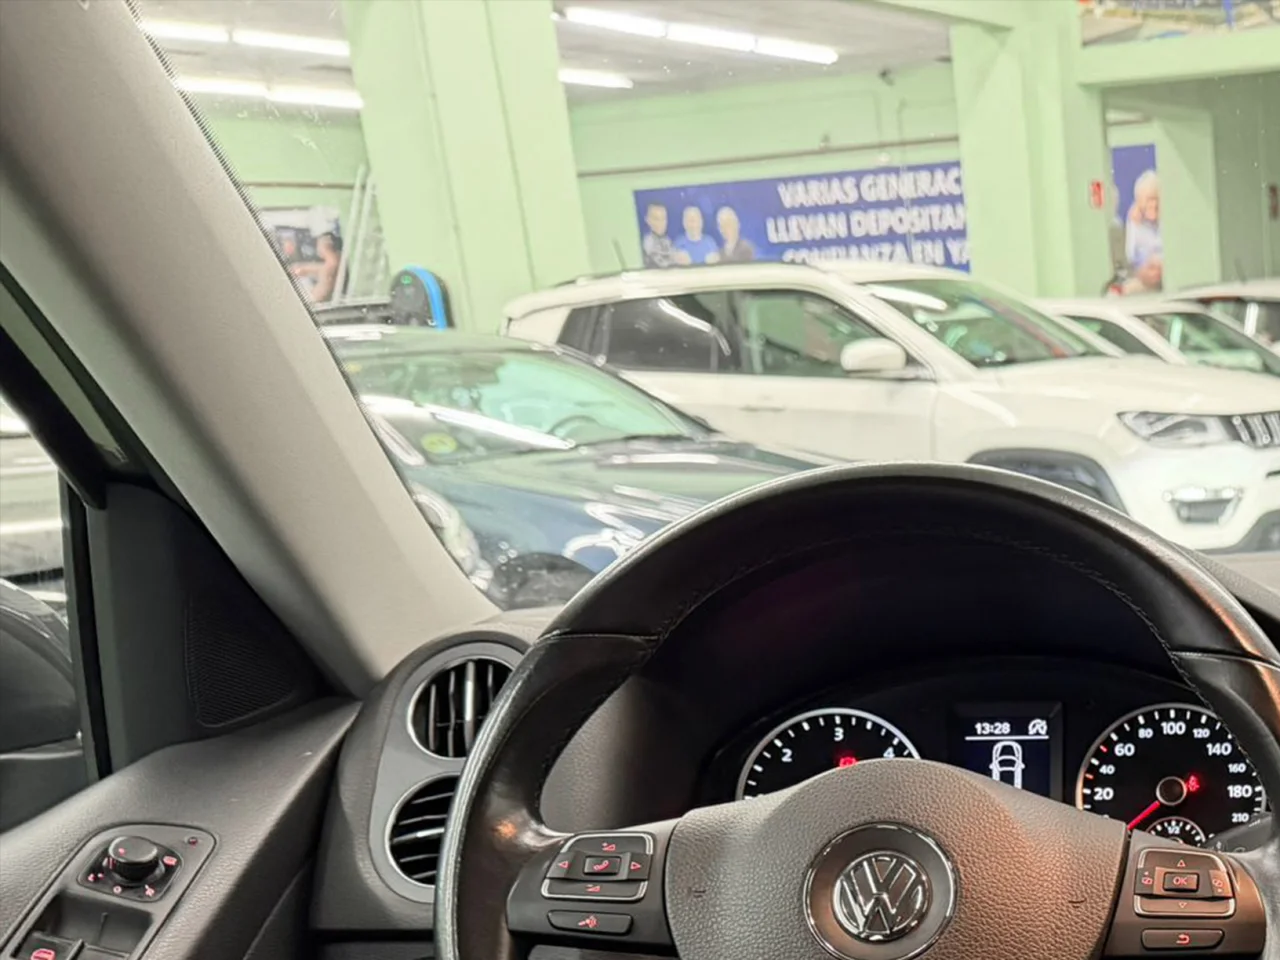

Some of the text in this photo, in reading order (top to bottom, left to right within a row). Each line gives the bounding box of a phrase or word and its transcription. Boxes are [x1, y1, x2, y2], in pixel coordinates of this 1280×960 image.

[777, 177, 859, 209] VARIAS
[766, 211, 848, 244] LLEVAN
[834, 727, 844, 741] 3
[975, 722, 1010, 735] 13:28
[1138, 727, 1153, 739] 80
[1161, 721, 1186, 735] 100
[1193, 727, 1210, 738] 120
[781, 748, 793, 762] 2
[883, 747, 895, 759] 4
[1114, 743, 1135, 757] 60
[1206, 742, 1232, 756] 140
[1099, 764, 1115, 775] 40
[1228, 763, 1246, 773] 160
[1093, 787, 1114, 801] 20
[1227, 785, 1252, 798] 180
[1232, 812, 1249, 823] 210
[1173, 876, 1188, 885] OK
